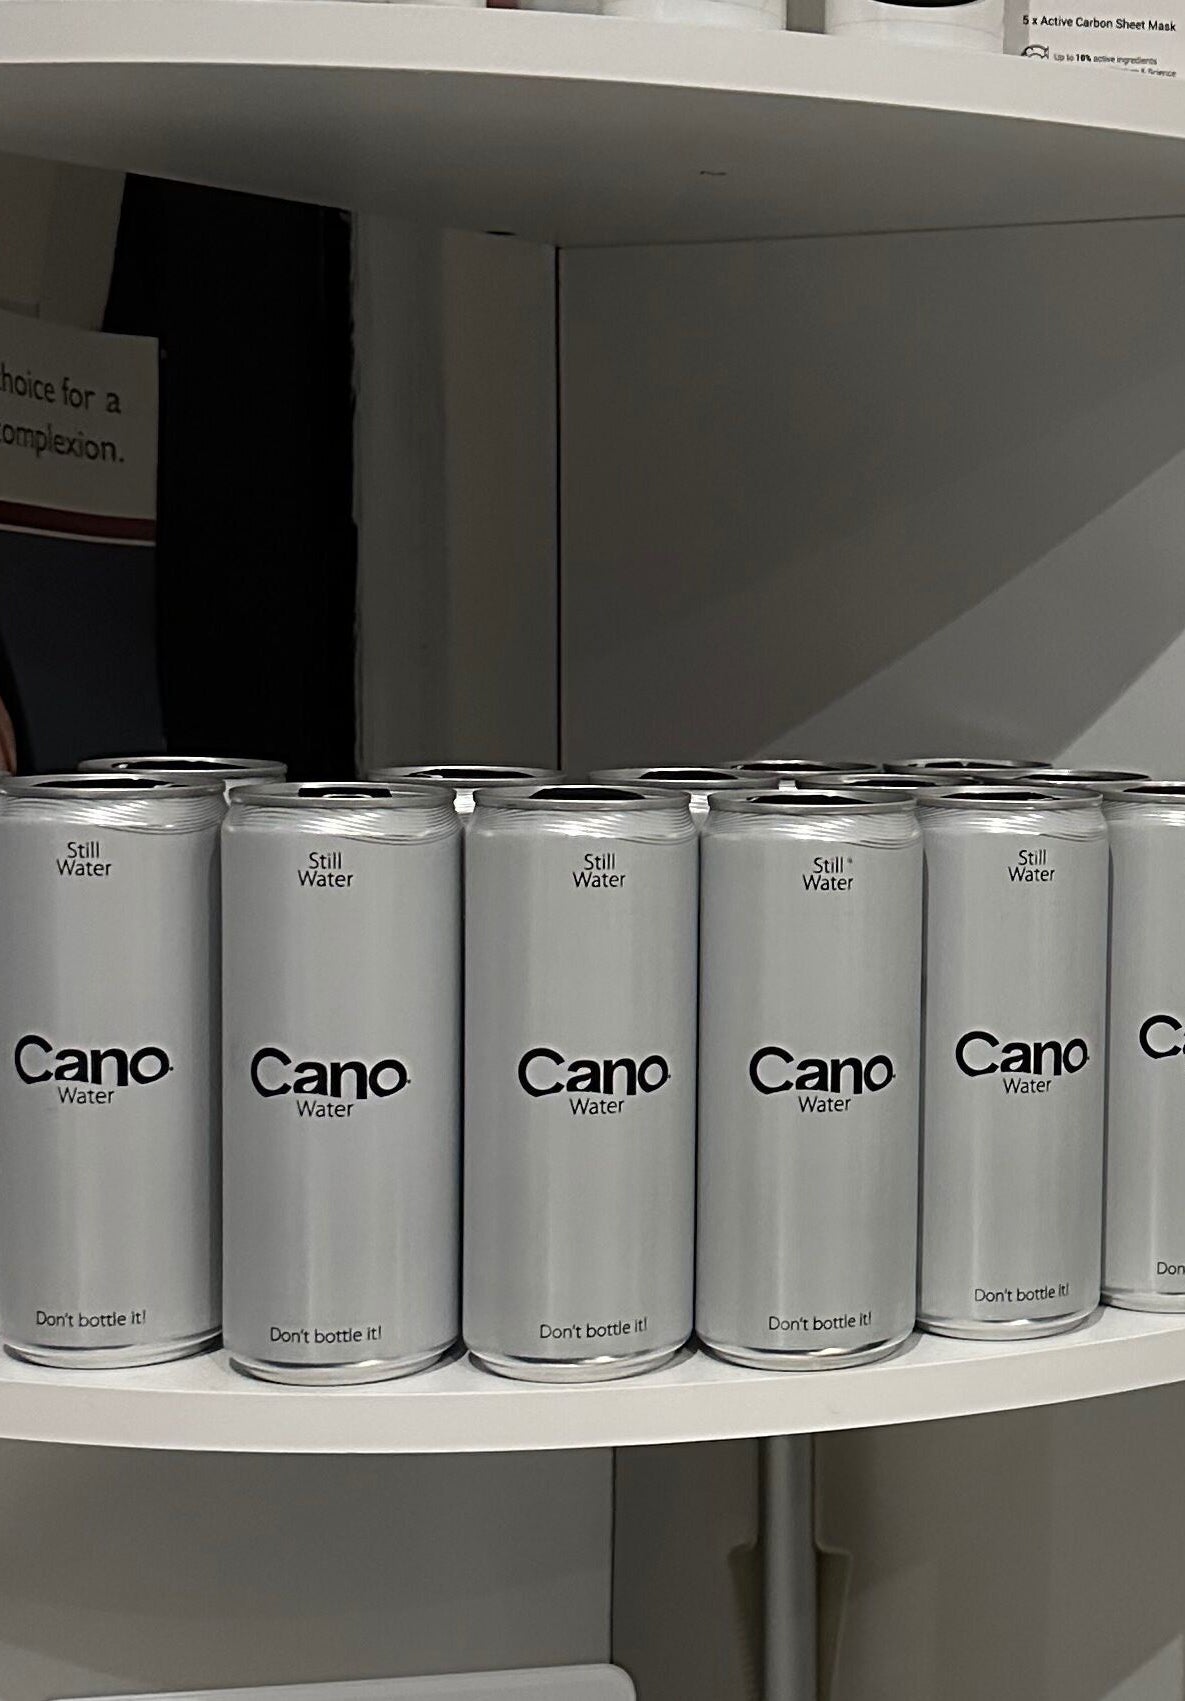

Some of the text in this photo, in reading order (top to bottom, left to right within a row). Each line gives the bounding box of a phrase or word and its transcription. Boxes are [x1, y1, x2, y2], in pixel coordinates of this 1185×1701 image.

[1022, 14, 1030, 25] 5
[1040, 16, 1073, 28] Active
[1075, 17, 1113, 29] Carbon
[1115, 18, 1145, 31] Sheet
[1148, 20, 1177, 32] Mask
[0, 362, 122, 415] hoice for a
[0, 422, 125, 463] omplexion.
[67, 840, 99, 858] Still
[1017, 849, 1047, 865] Still
[56, 859, 113, 876] Water
[308, 851, 342, 869] Still
[583, 853, 616, 870] Still
[813, 856, 844, 873] Still
[298, 870, 354, 887] Water
[572, 871, 627, 888] Water
[802, 873, 854, 891] Water
[1008, 866, 1056, 883] Water
[1003, 1078, 1052, 1094] Water
[58, 1087, 116, 1105] Water
[798, 1096, 852, 1113] Water
[297, 1100, 355, 1118] Water
[569, 1098, 625, 1115] Water
[974, 1281, 1070, 1302] Don't bottle it!
[36, 1309, 147, 1328] Don't bottle it!
[540, 1316, 648, 1339] Don't bottle it!
[769, 1311, 871, 1332] Don't bottle it!
[270, 1325, 382, 1344] Don't bottle it!
